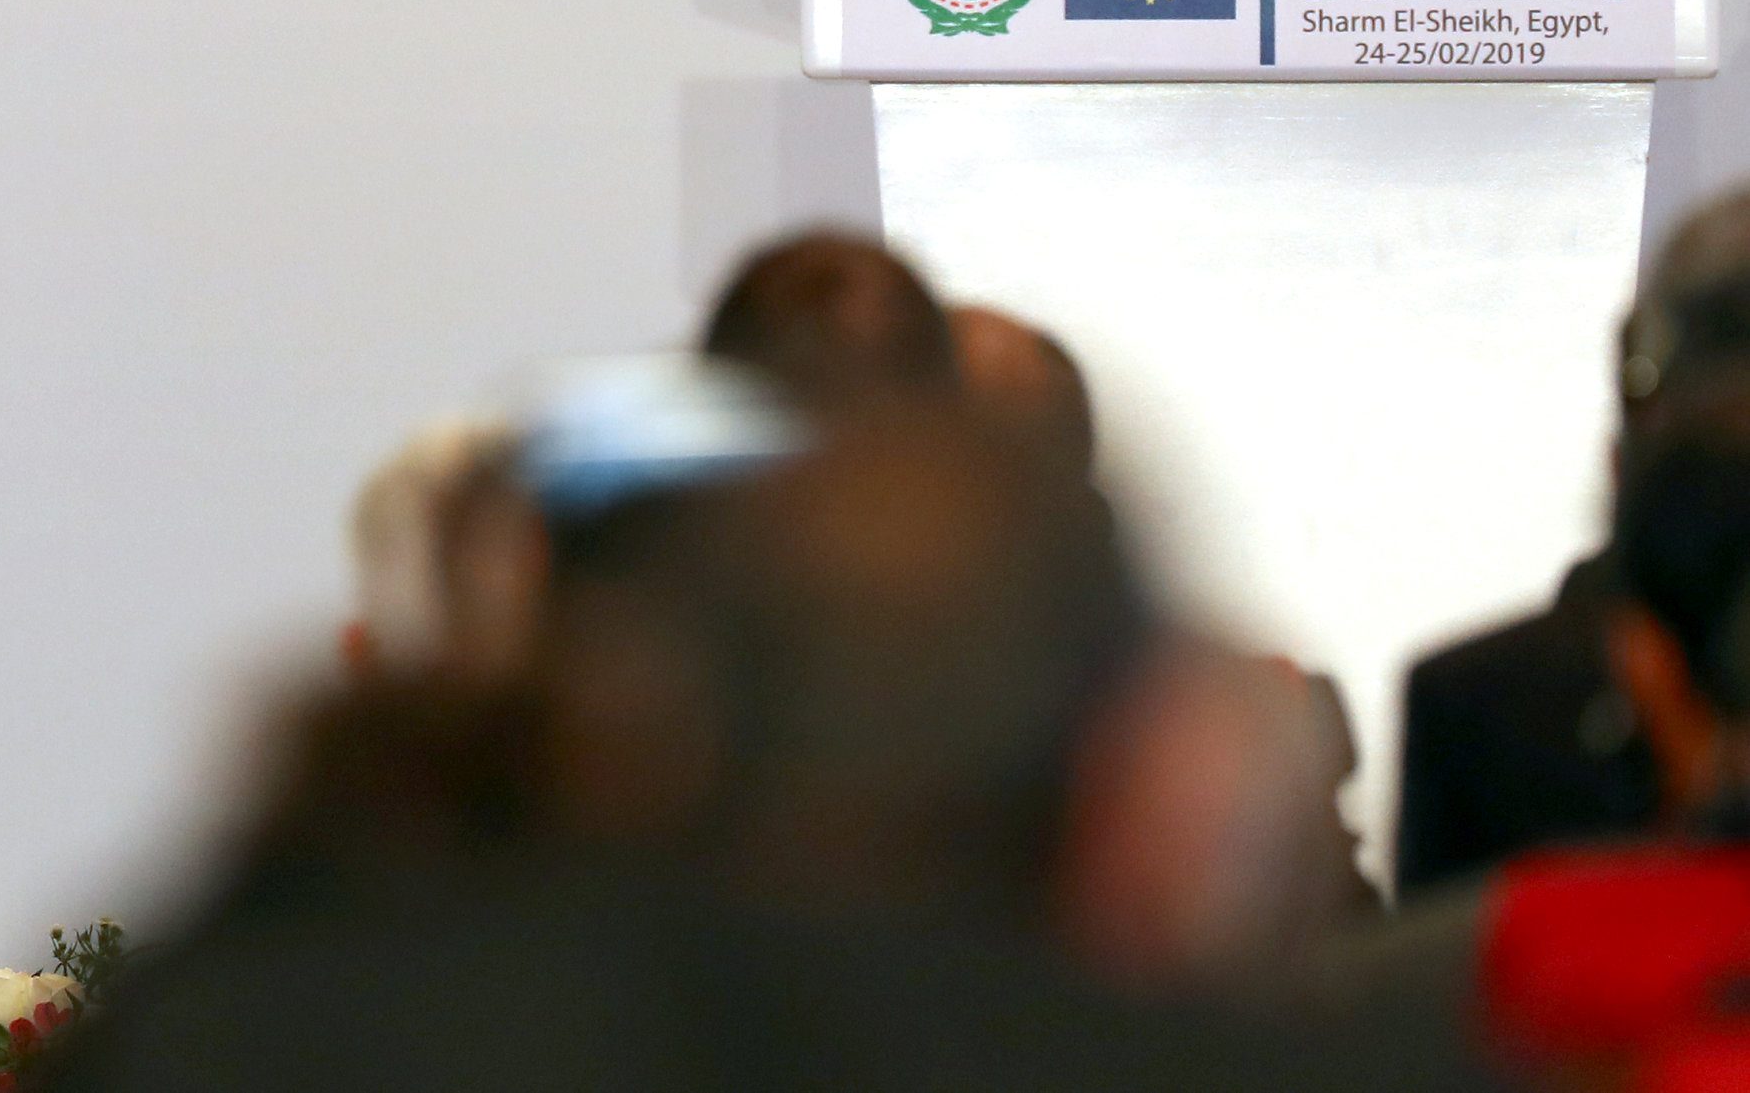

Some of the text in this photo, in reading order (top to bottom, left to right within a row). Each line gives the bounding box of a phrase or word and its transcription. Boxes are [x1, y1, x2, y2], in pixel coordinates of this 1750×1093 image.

[1303, 9, 1610, 38] Sharm El-Sheikh, Egypt,
[1355, 42, 1547, 67] 24-25/02/2019
